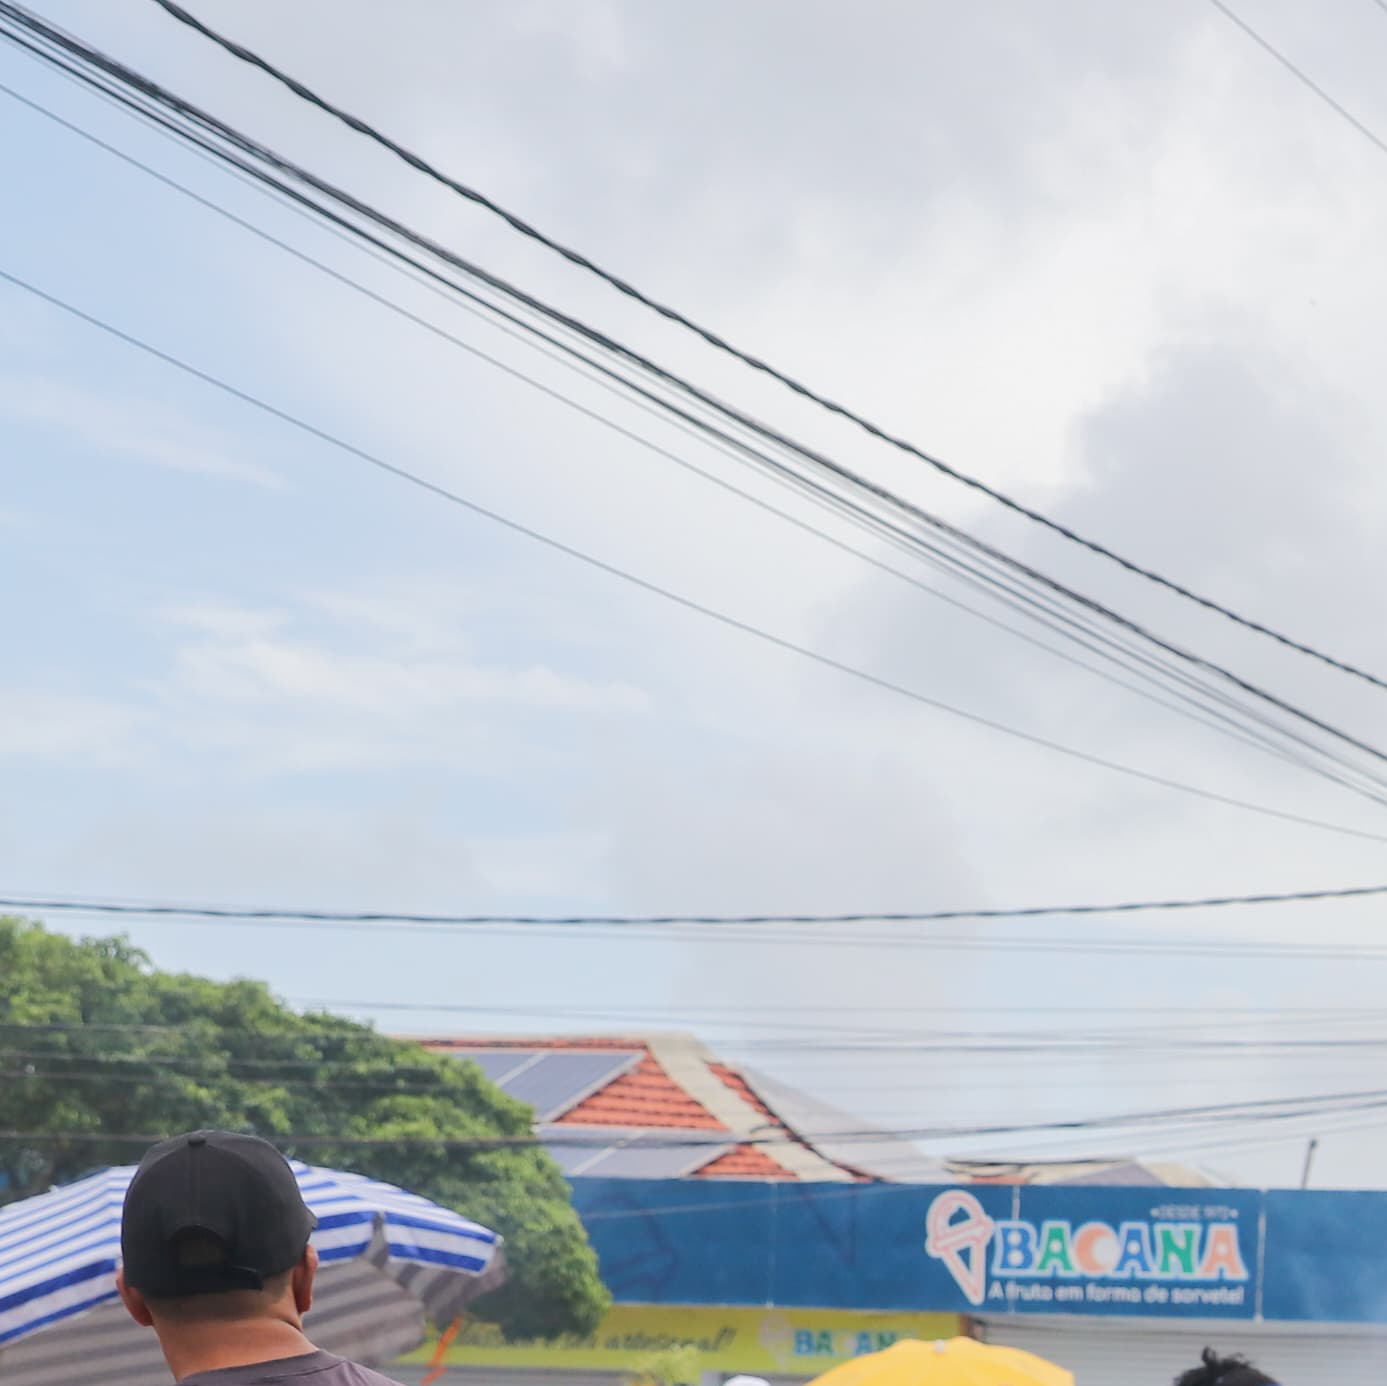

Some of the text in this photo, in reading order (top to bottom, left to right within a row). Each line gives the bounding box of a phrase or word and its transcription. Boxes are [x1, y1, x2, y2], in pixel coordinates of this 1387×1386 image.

[991, 1221, 1249, 1280] BACANA
[988, 1280, 1005, 1299] A
[1005, 1280, 1054, 1301] fruta
[1055, 1285, 1084, 1302] em
[1085, 1282, 1142, 1303] forma
[1142, 1283, 1170, 1304] de
